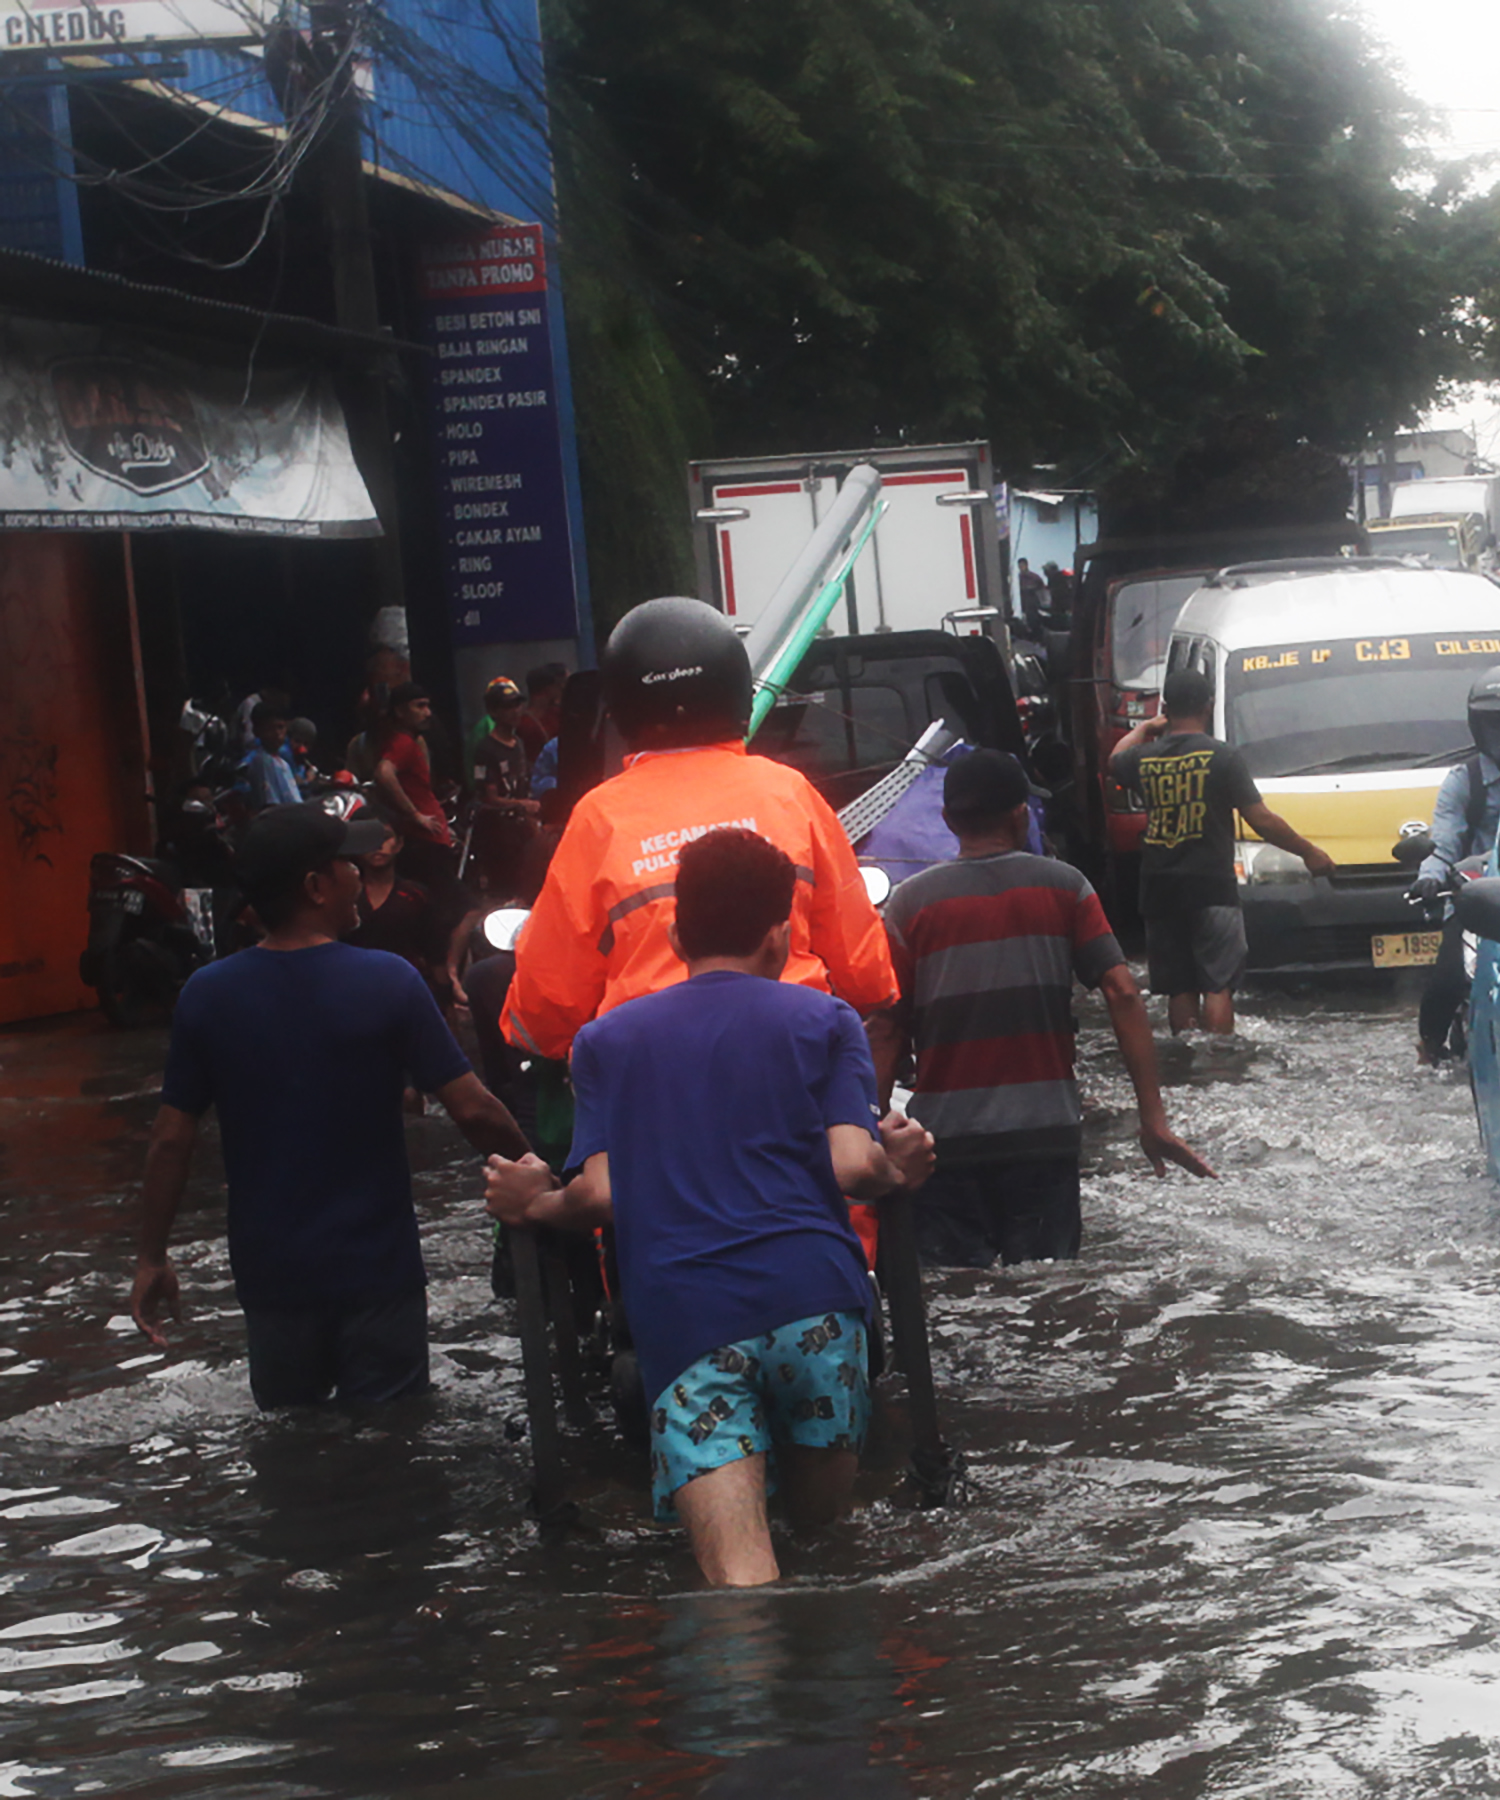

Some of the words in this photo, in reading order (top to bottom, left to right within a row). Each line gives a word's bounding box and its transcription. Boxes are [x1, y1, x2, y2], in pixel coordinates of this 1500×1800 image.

[5, 9, 126, 45] CILEDUG
[481, 262, 534, 285] PROMO
[436, 314, 467, 331] BESI
[469, 310, 515, 330] BETON
[518, 308, 542, 326] SNI
[438, 341, 473, 359] BAJA
[476, 337, 529, 356] RINGAN
[441, 366, 503, 386] SPANDEX
[443, 394, 505, 413] SPANDEX
[507, 390, 547, 408] PASIR
[446, 421, 483, 439] HOLO
[448, 449, 479, 467] PIPA
[450, 473, 522, 493] WIREMESH
[453, 501, 510, 520] BONDEX
[455, 528, 503, 547] CAKAR
[506, 525, 543, 543] AYAM
[458, 555, 493, 573] RING
[462, 581, 504, 600] SLOOF
[1355, 638, 1411, 662] C.13
[1139, 756, 1212, 776] ENEMY
[1139, 768, 1211, 807] FIGHT
[640, 816, 757, 855] KECAMN
[1375, 937, 1385, 957] B
